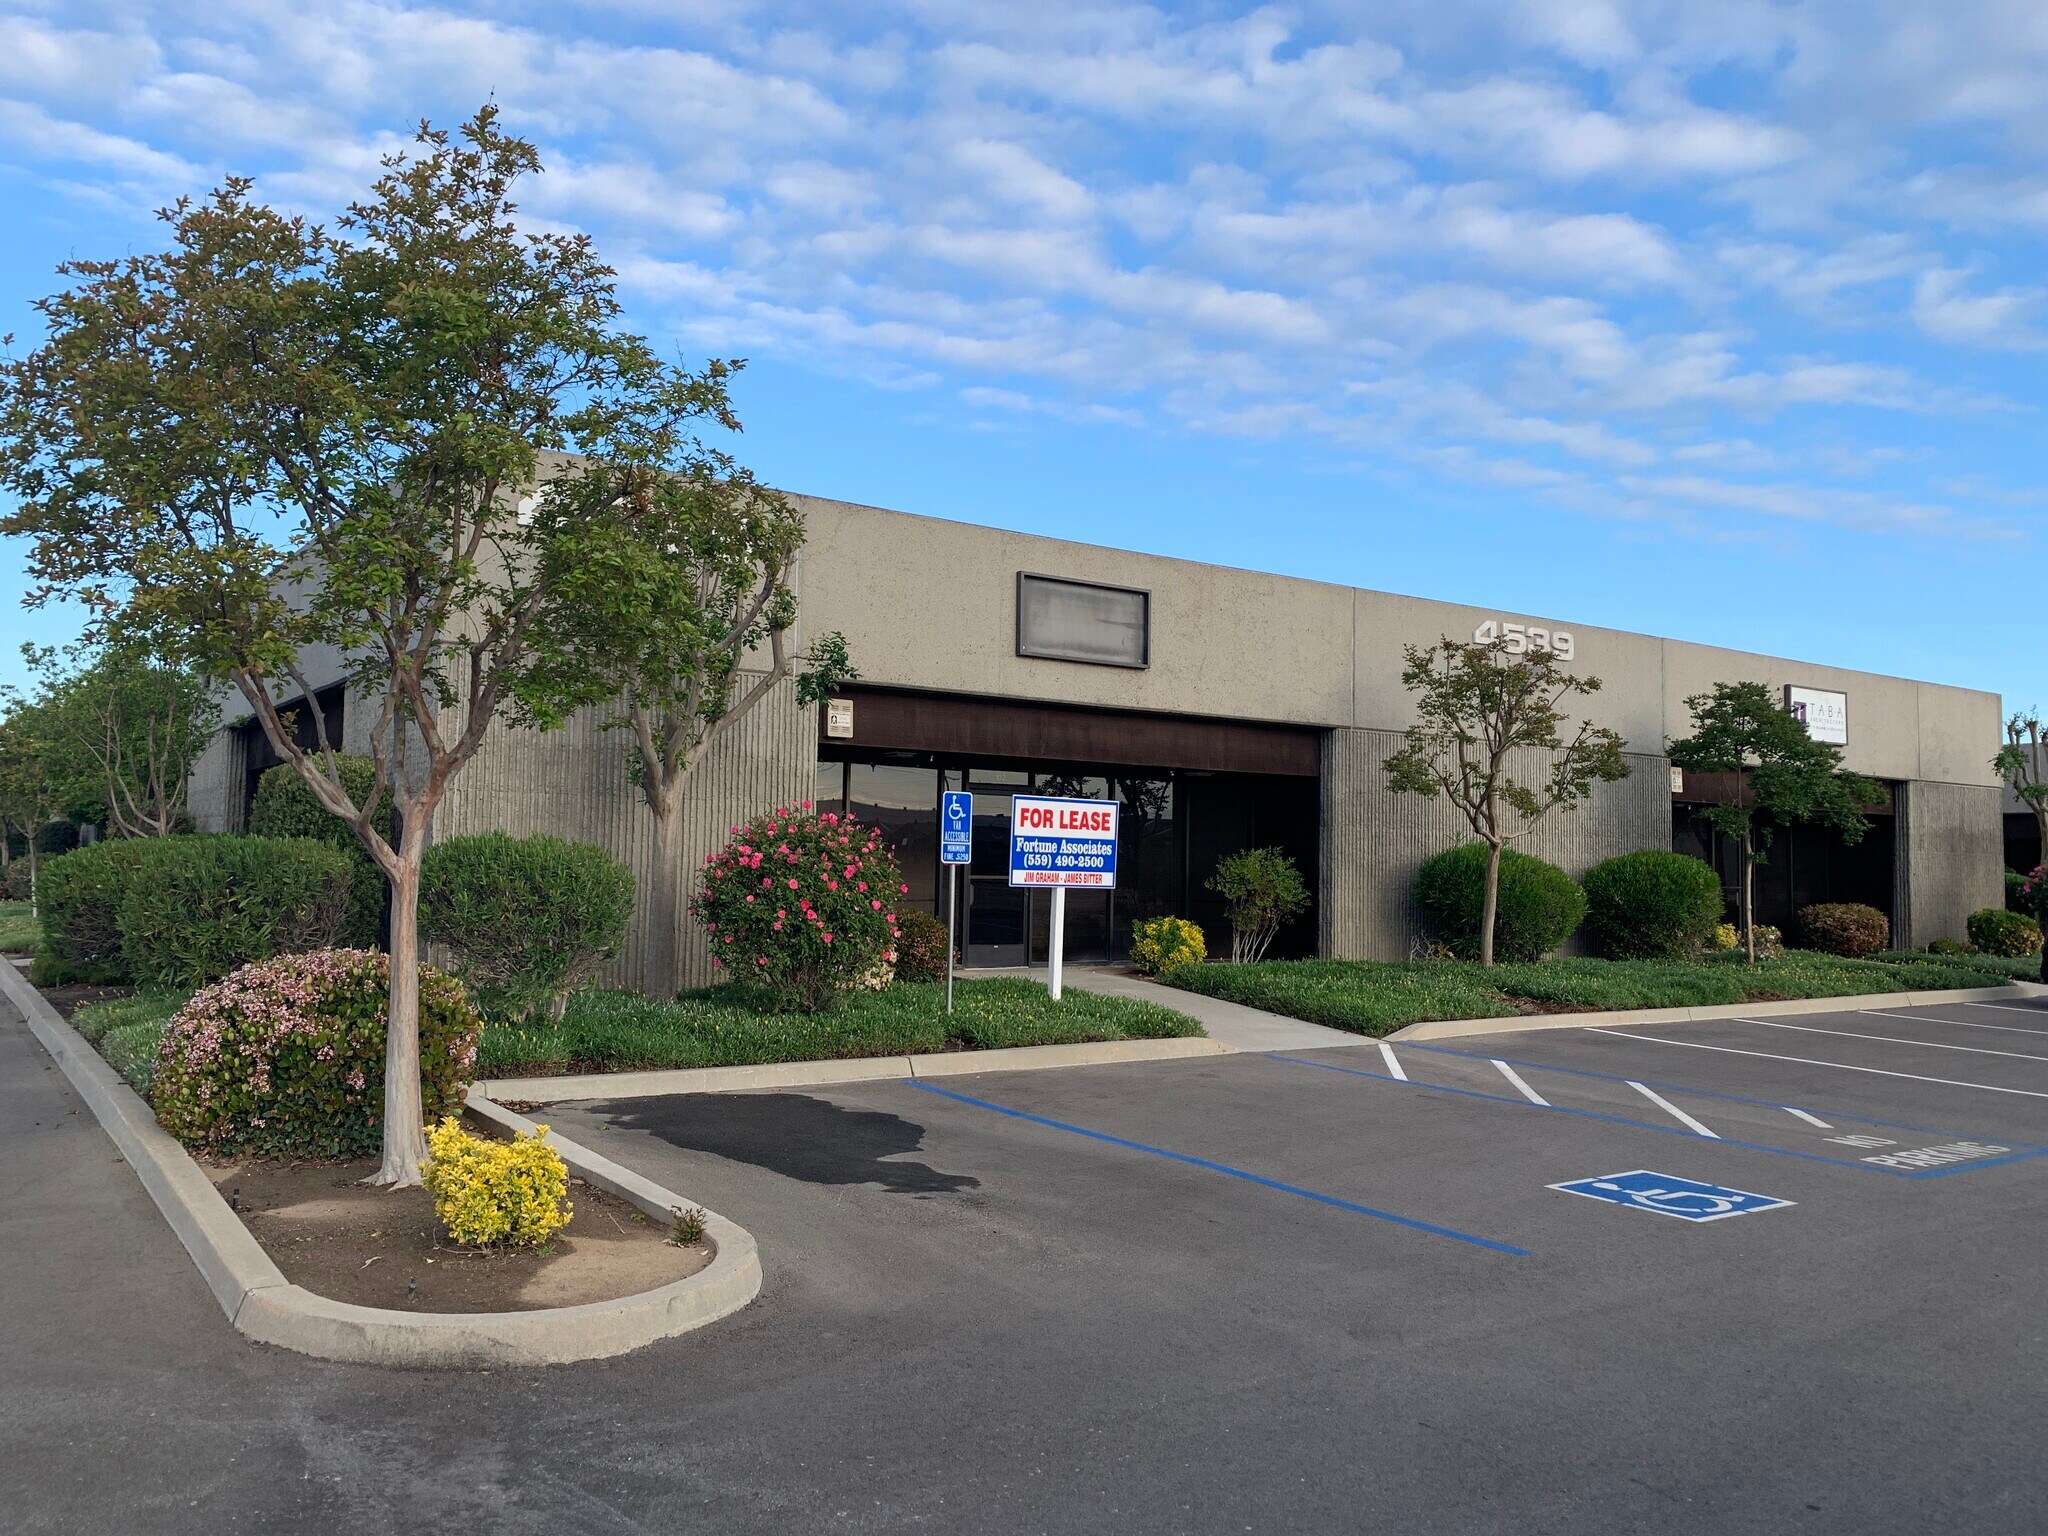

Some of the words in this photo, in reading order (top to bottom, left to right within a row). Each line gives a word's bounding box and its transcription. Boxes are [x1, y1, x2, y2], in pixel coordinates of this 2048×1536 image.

[1473, 620, 1575, 661] 4539
[952, 820, 962, 831] VAN
[1020, 808, 1054, 829] FOR
[1059, 810, 1111, 832] LEASE
[944, 831, 969, 842] ACCESSIBLE
[947, 844, 966, 853] MINIMUM
[1016, 837, 1058, 854] Fortune
[1059, 839, 1113, 856] Associates
[943, 852, 954, 861] FINE
[1023, 853, 1052, 869] (559)
[1054, 854, 1104, 868] 490-2500
[1024, 872, 1035, 883] JIM
[1035, 872, 1060, 884] GRAHAM
[1064, 873, 1082, 884] JAMES
[1083, 873, 1103, 885] BITTER
[1822, 1134, 1898, 1149] NO
[1859, 1141, 2012, 1170] PARKING
